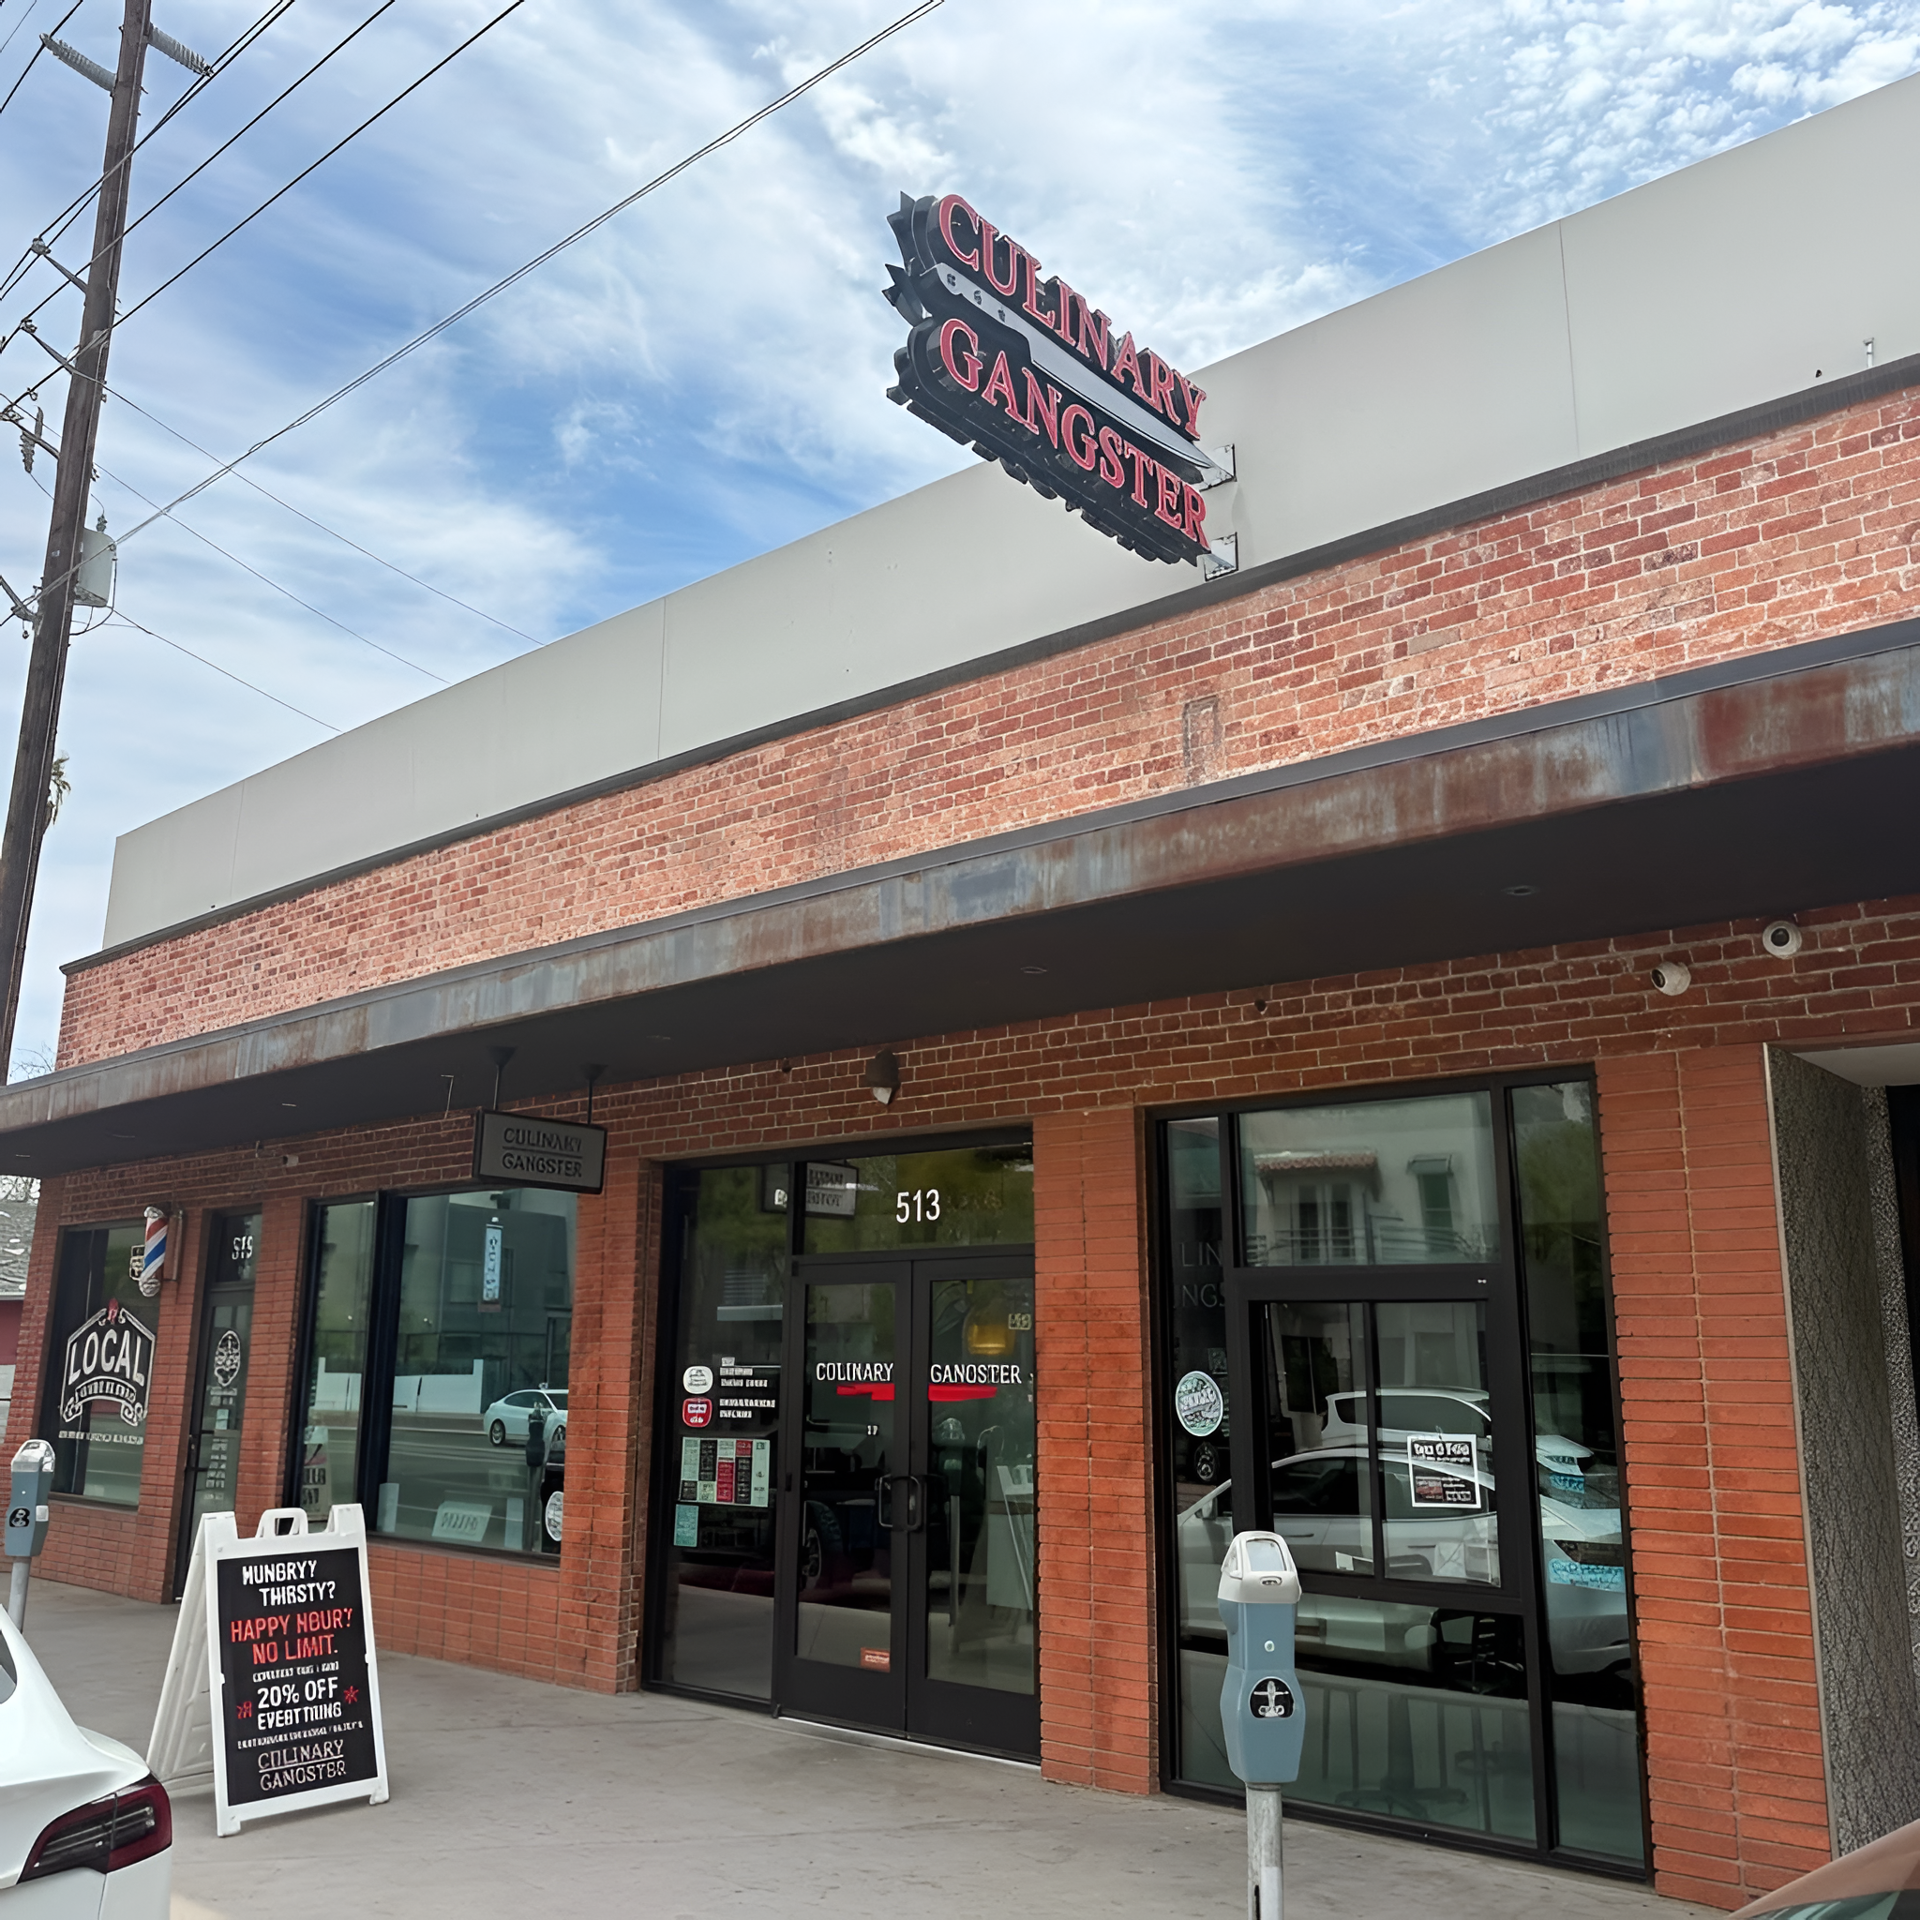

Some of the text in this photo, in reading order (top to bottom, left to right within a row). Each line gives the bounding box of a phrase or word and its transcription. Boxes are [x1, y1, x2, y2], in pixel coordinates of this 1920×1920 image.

[939, 194, 1207, 441] CULINARY
[939, 318, 1210, 550] GANGSTER
[896, 1189, 941, 1223] 513
[68, 1329, 145, 1386] LOCAL
[231, 1614, 290, 1642] HAPPY
[252, 1641, 278, 1664] NO
[257, 1677, 338, 1709] 20% OFF
